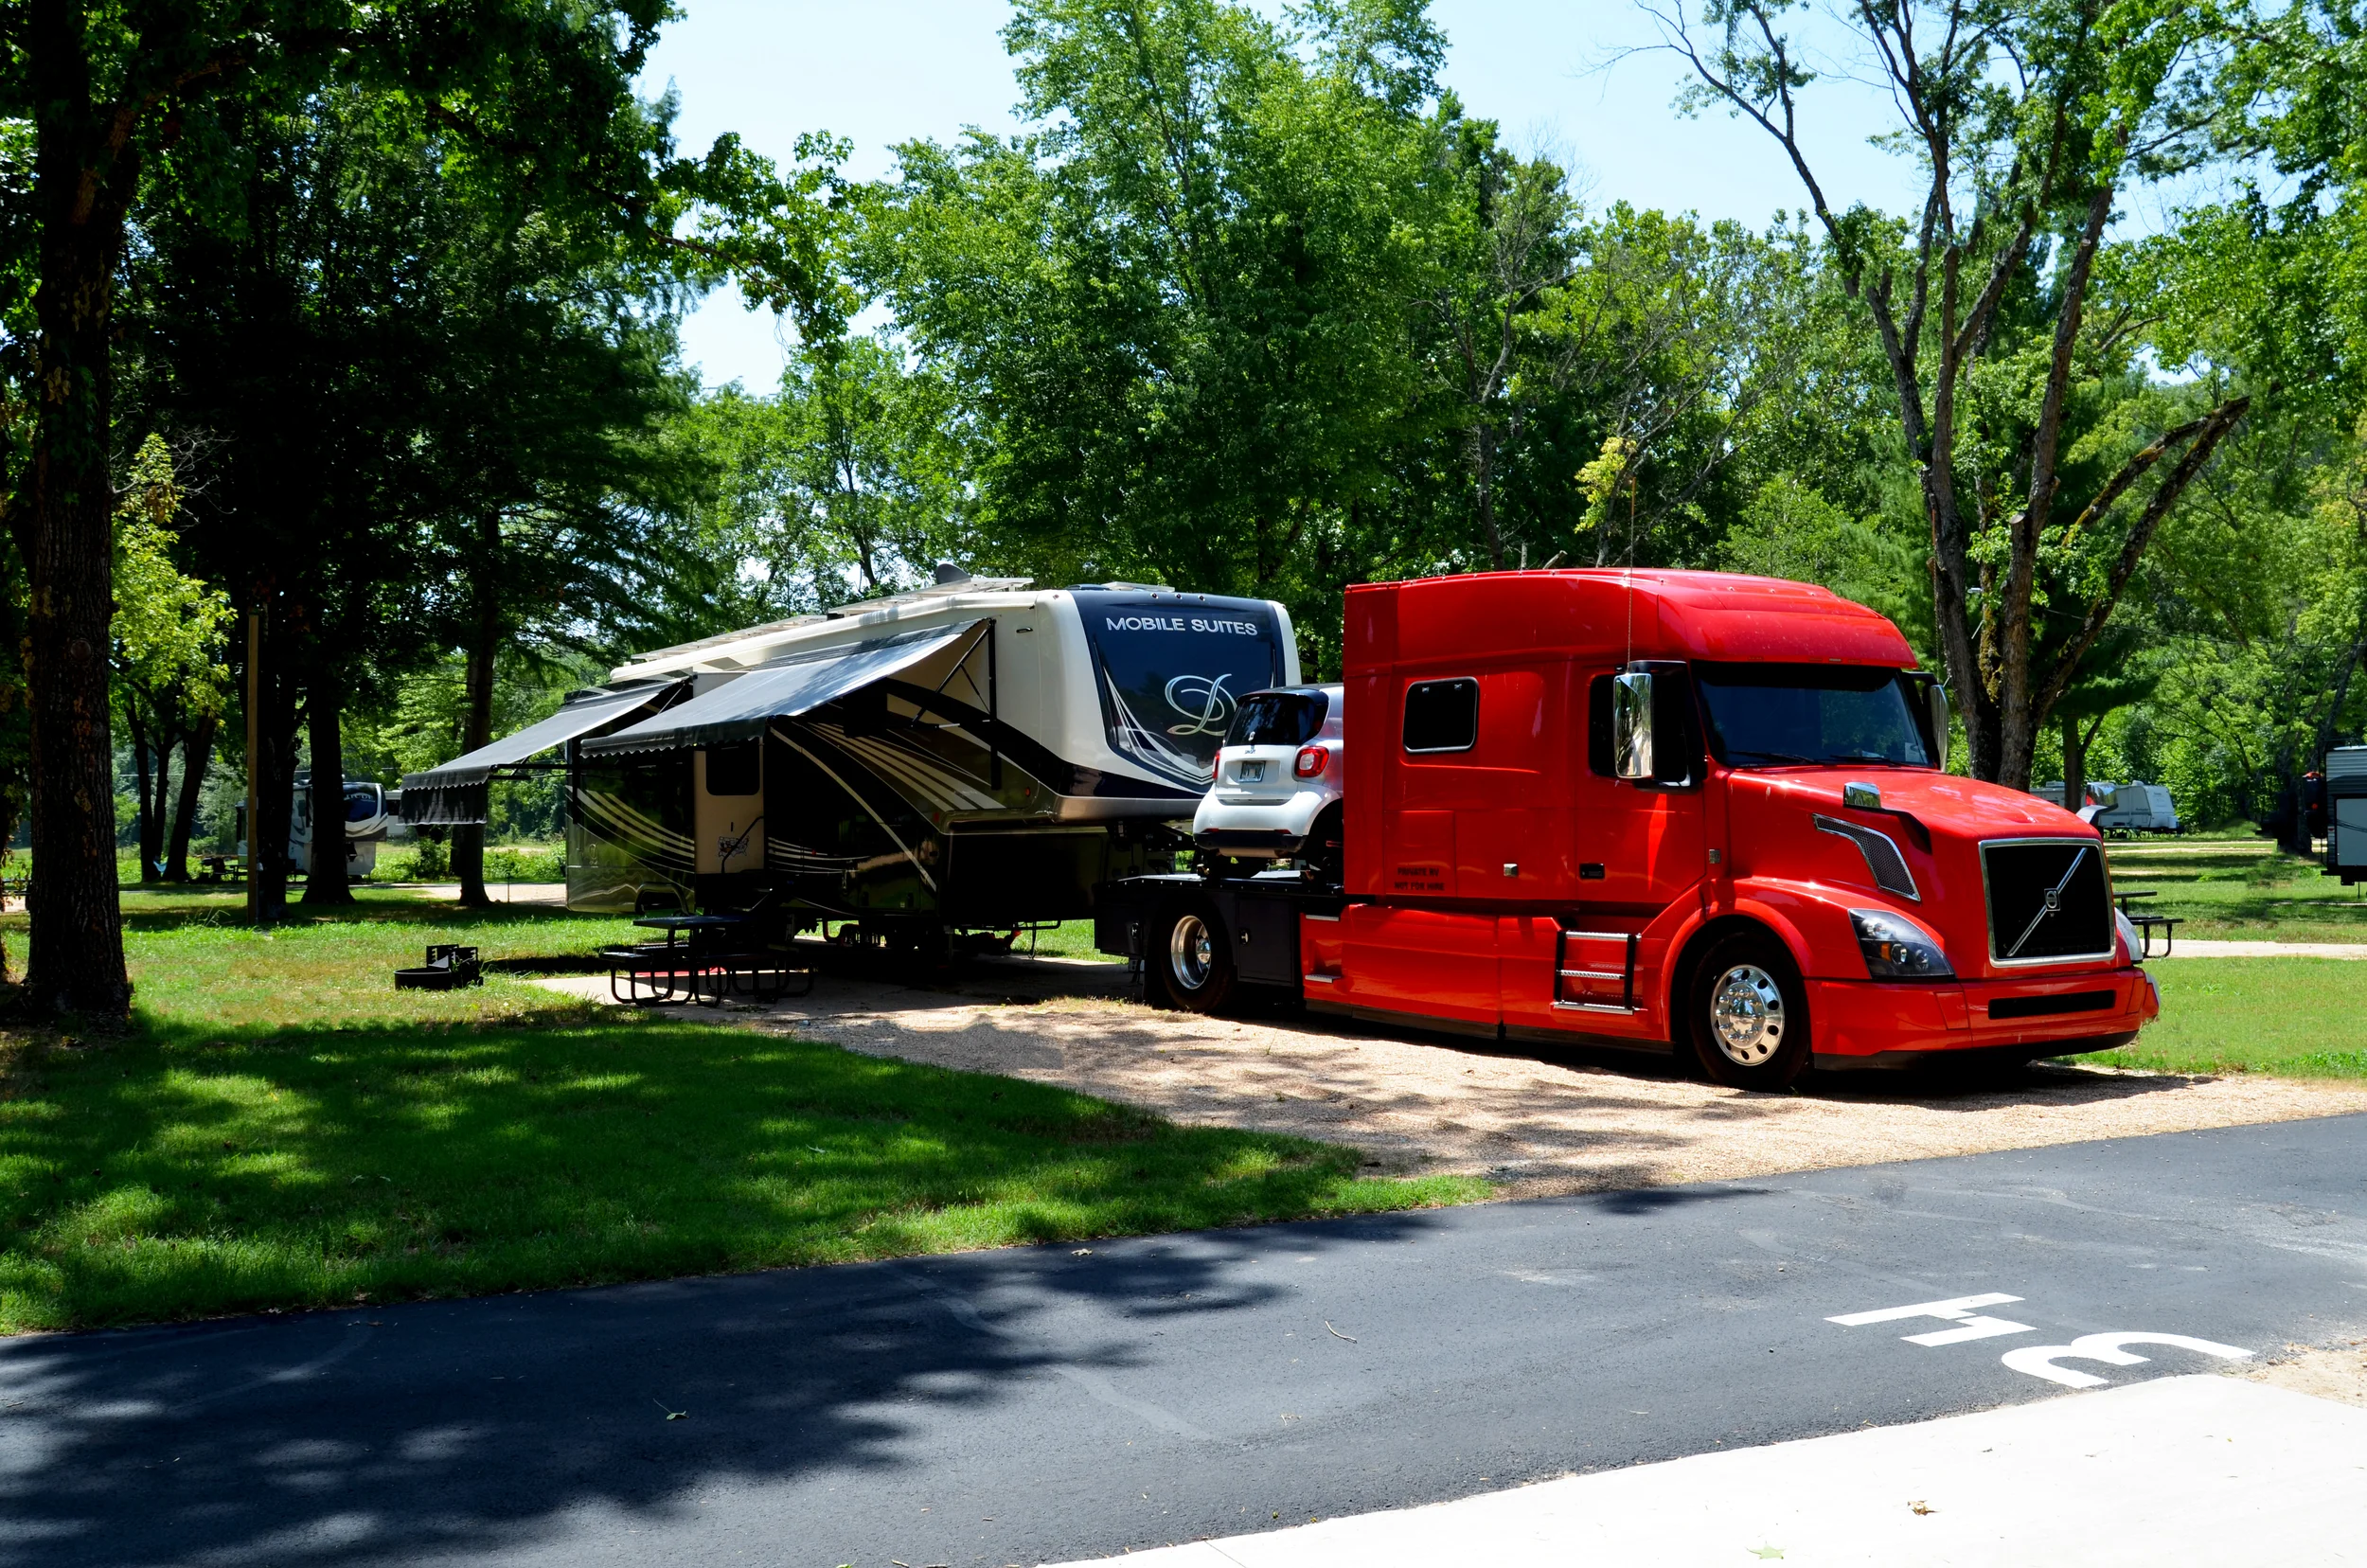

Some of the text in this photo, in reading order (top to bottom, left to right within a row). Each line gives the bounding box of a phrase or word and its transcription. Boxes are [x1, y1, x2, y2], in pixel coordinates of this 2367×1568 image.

[1106, 617, 1258, 635] MOBILE SUITES
[1397, 867, 1439, 877] PRIVATE RV
[1395, 882, 1445, 891] NOT FOR HIRE
